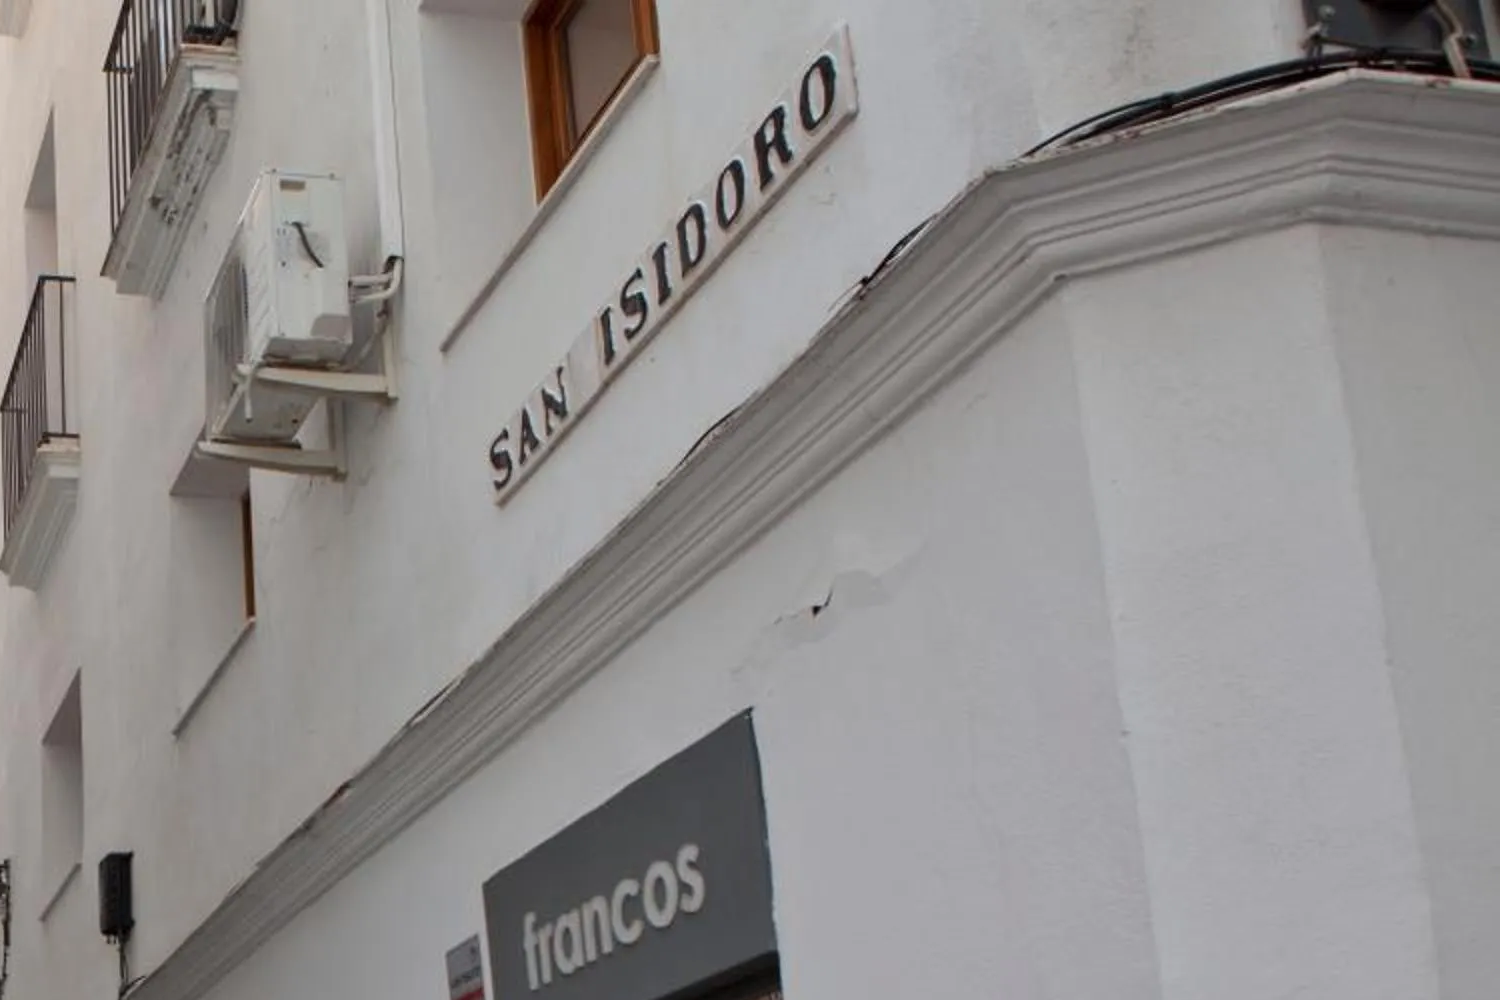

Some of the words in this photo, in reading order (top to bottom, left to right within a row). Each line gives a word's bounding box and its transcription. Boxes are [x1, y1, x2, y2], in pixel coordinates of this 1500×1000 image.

[489, 366, 569, 490] SAN
[600, 53, 837, 367] ISIDORO
[523, 844, 706, 992] francos
